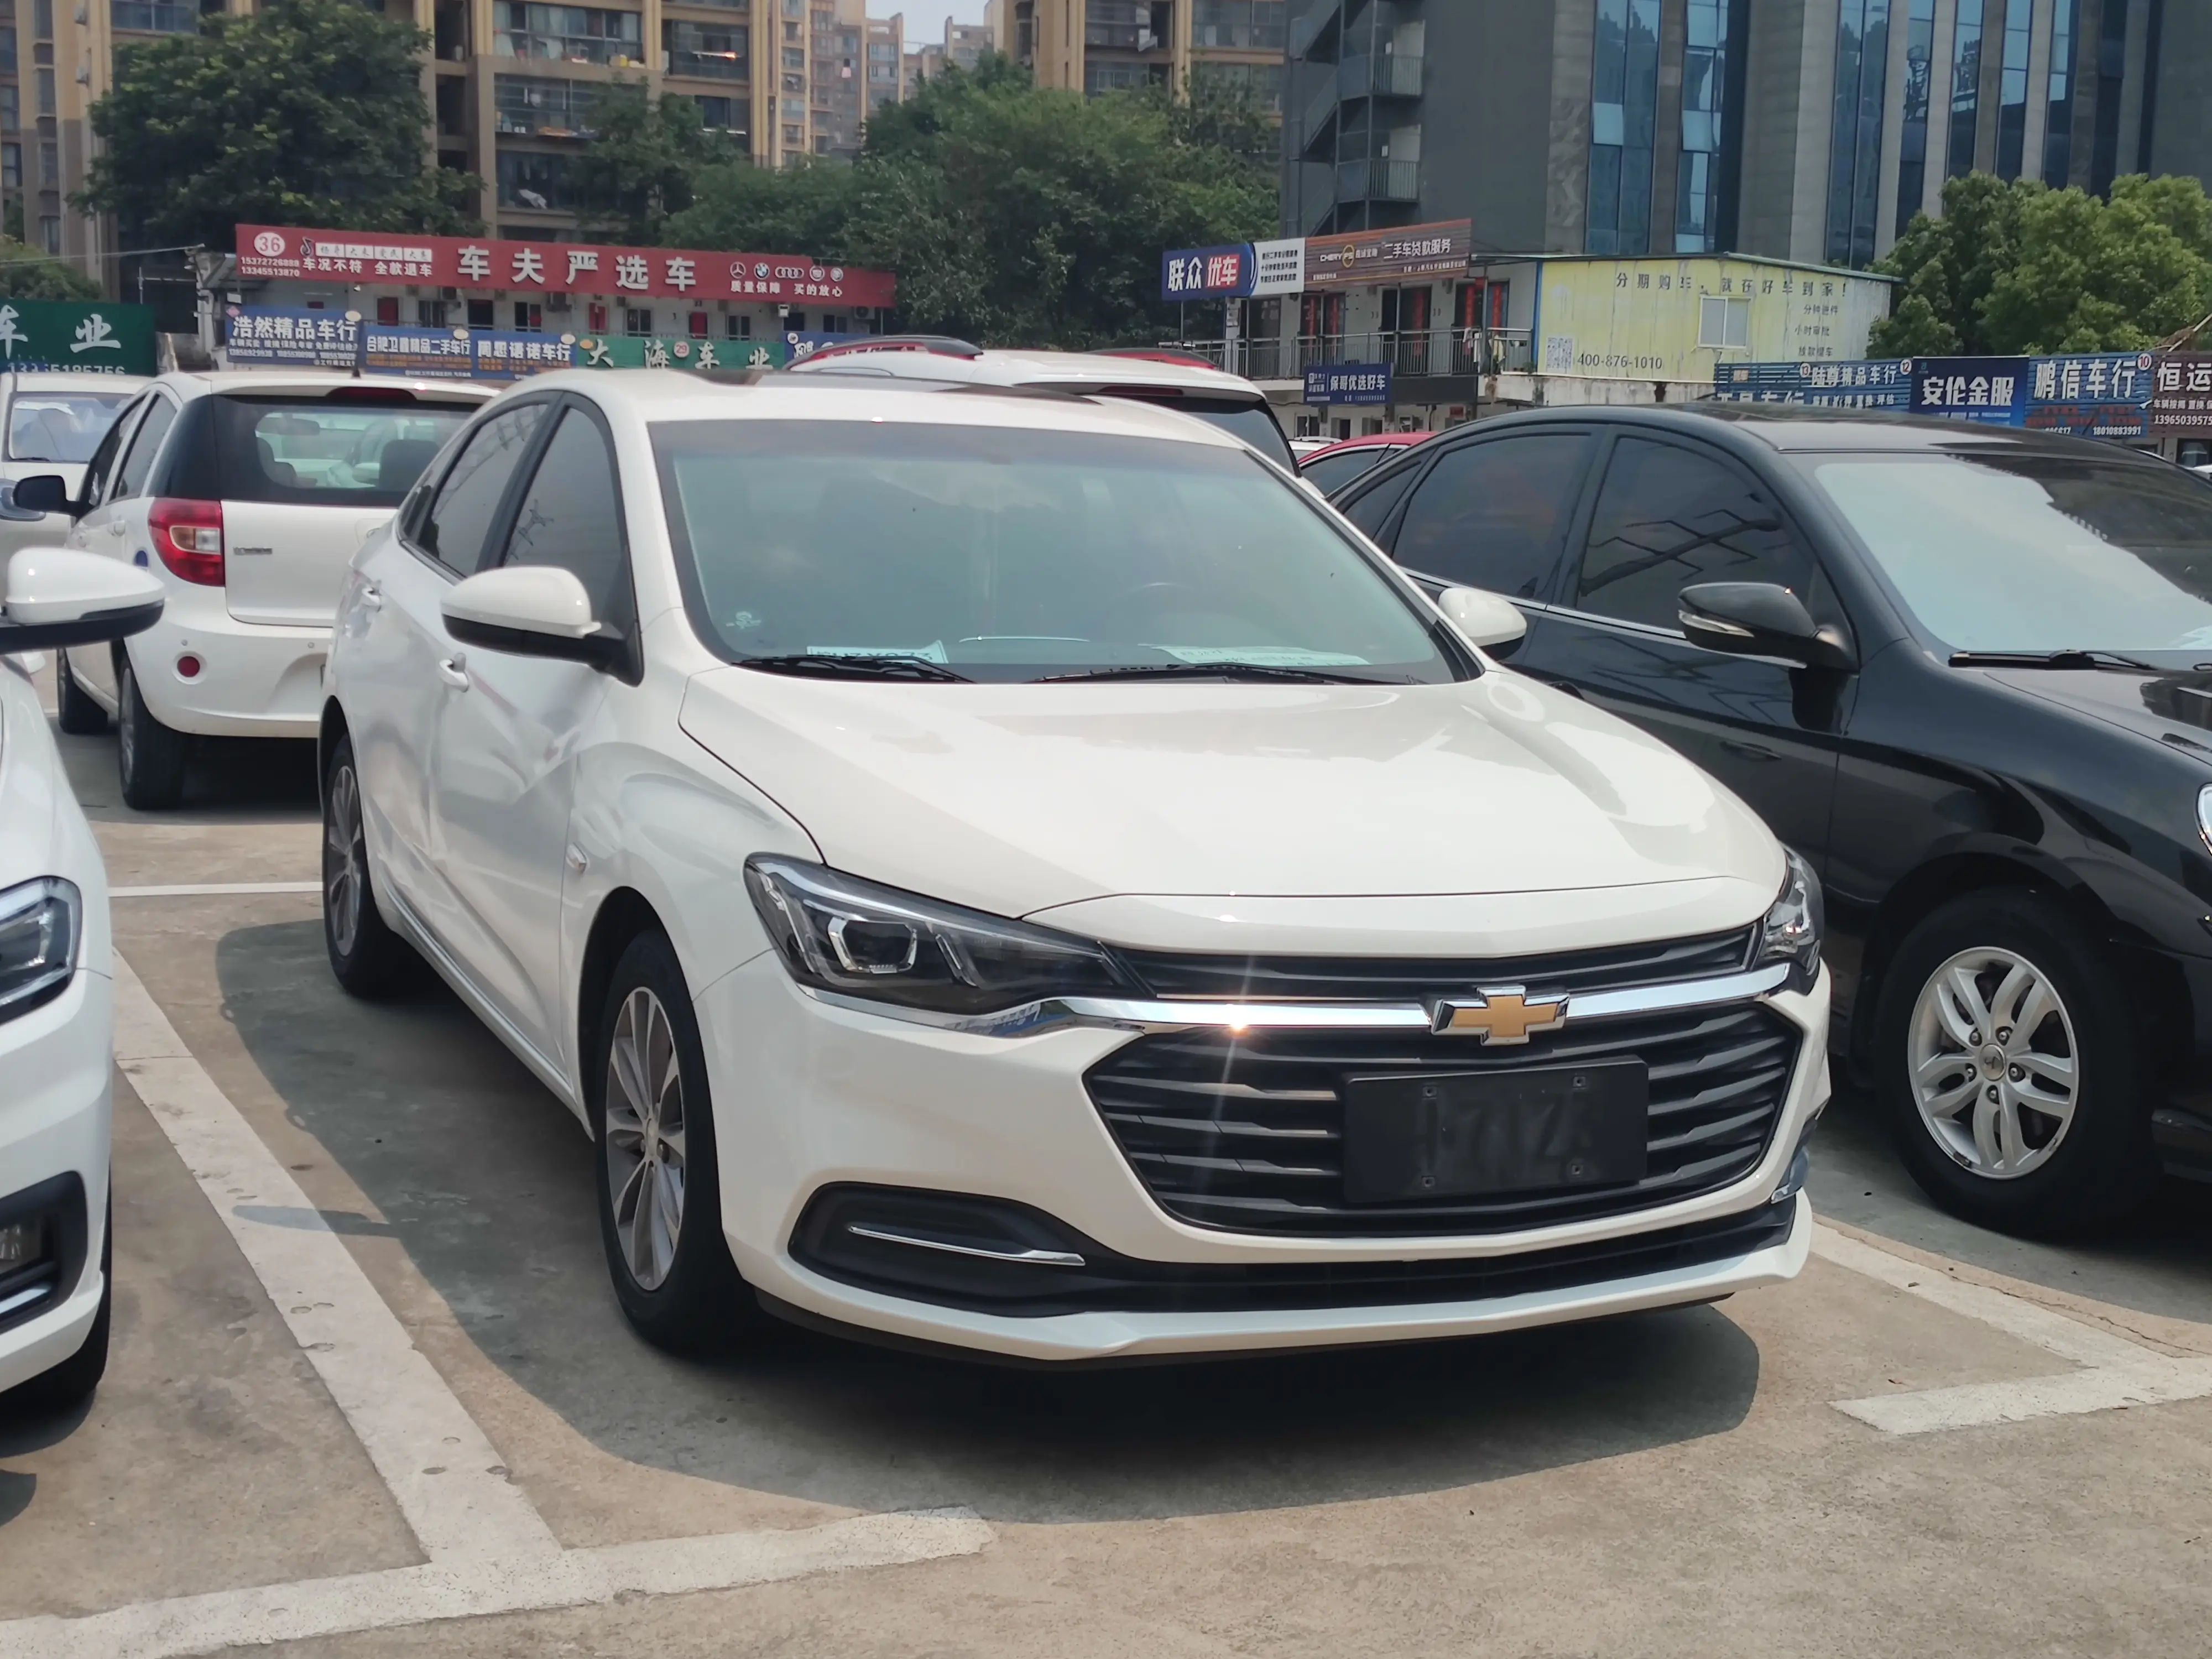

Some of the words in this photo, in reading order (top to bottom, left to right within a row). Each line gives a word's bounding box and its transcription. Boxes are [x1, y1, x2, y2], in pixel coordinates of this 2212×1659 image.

[259, 236, 280, 252] 36
[1383, 238, 1451, 259] 二手车贷款服务
[303, 257, 362, 273] 车况不符
[374, 261, 432, 277] 全款退车
[457, 245, 696, 291] 车夫严选车
[1167, 256, 1237, 291] 联众优车
[731, 280, 780, 294] 质量保障
[794, 283, 842, 298] 买的放心
[233, 315, 357, 341] 浩然精品车行
[587, 338, 774, 369] 大海车业
[676, 345, 687, 354] 29
[1577, 352, 1662, 369] 400-876-1010
[1802, 365, 1809, 376] 13
[1901, 361, 1911, 373] 12
[2140, 356, 2150, 368] 10
[2033, 359, 2136, 400] 鹏信车行
[2157, 361, 2212, 392] 恒运
[1921, 376, 2015, 406] 安伦金服
[2154, 414, 2212, 426] 13965039575
